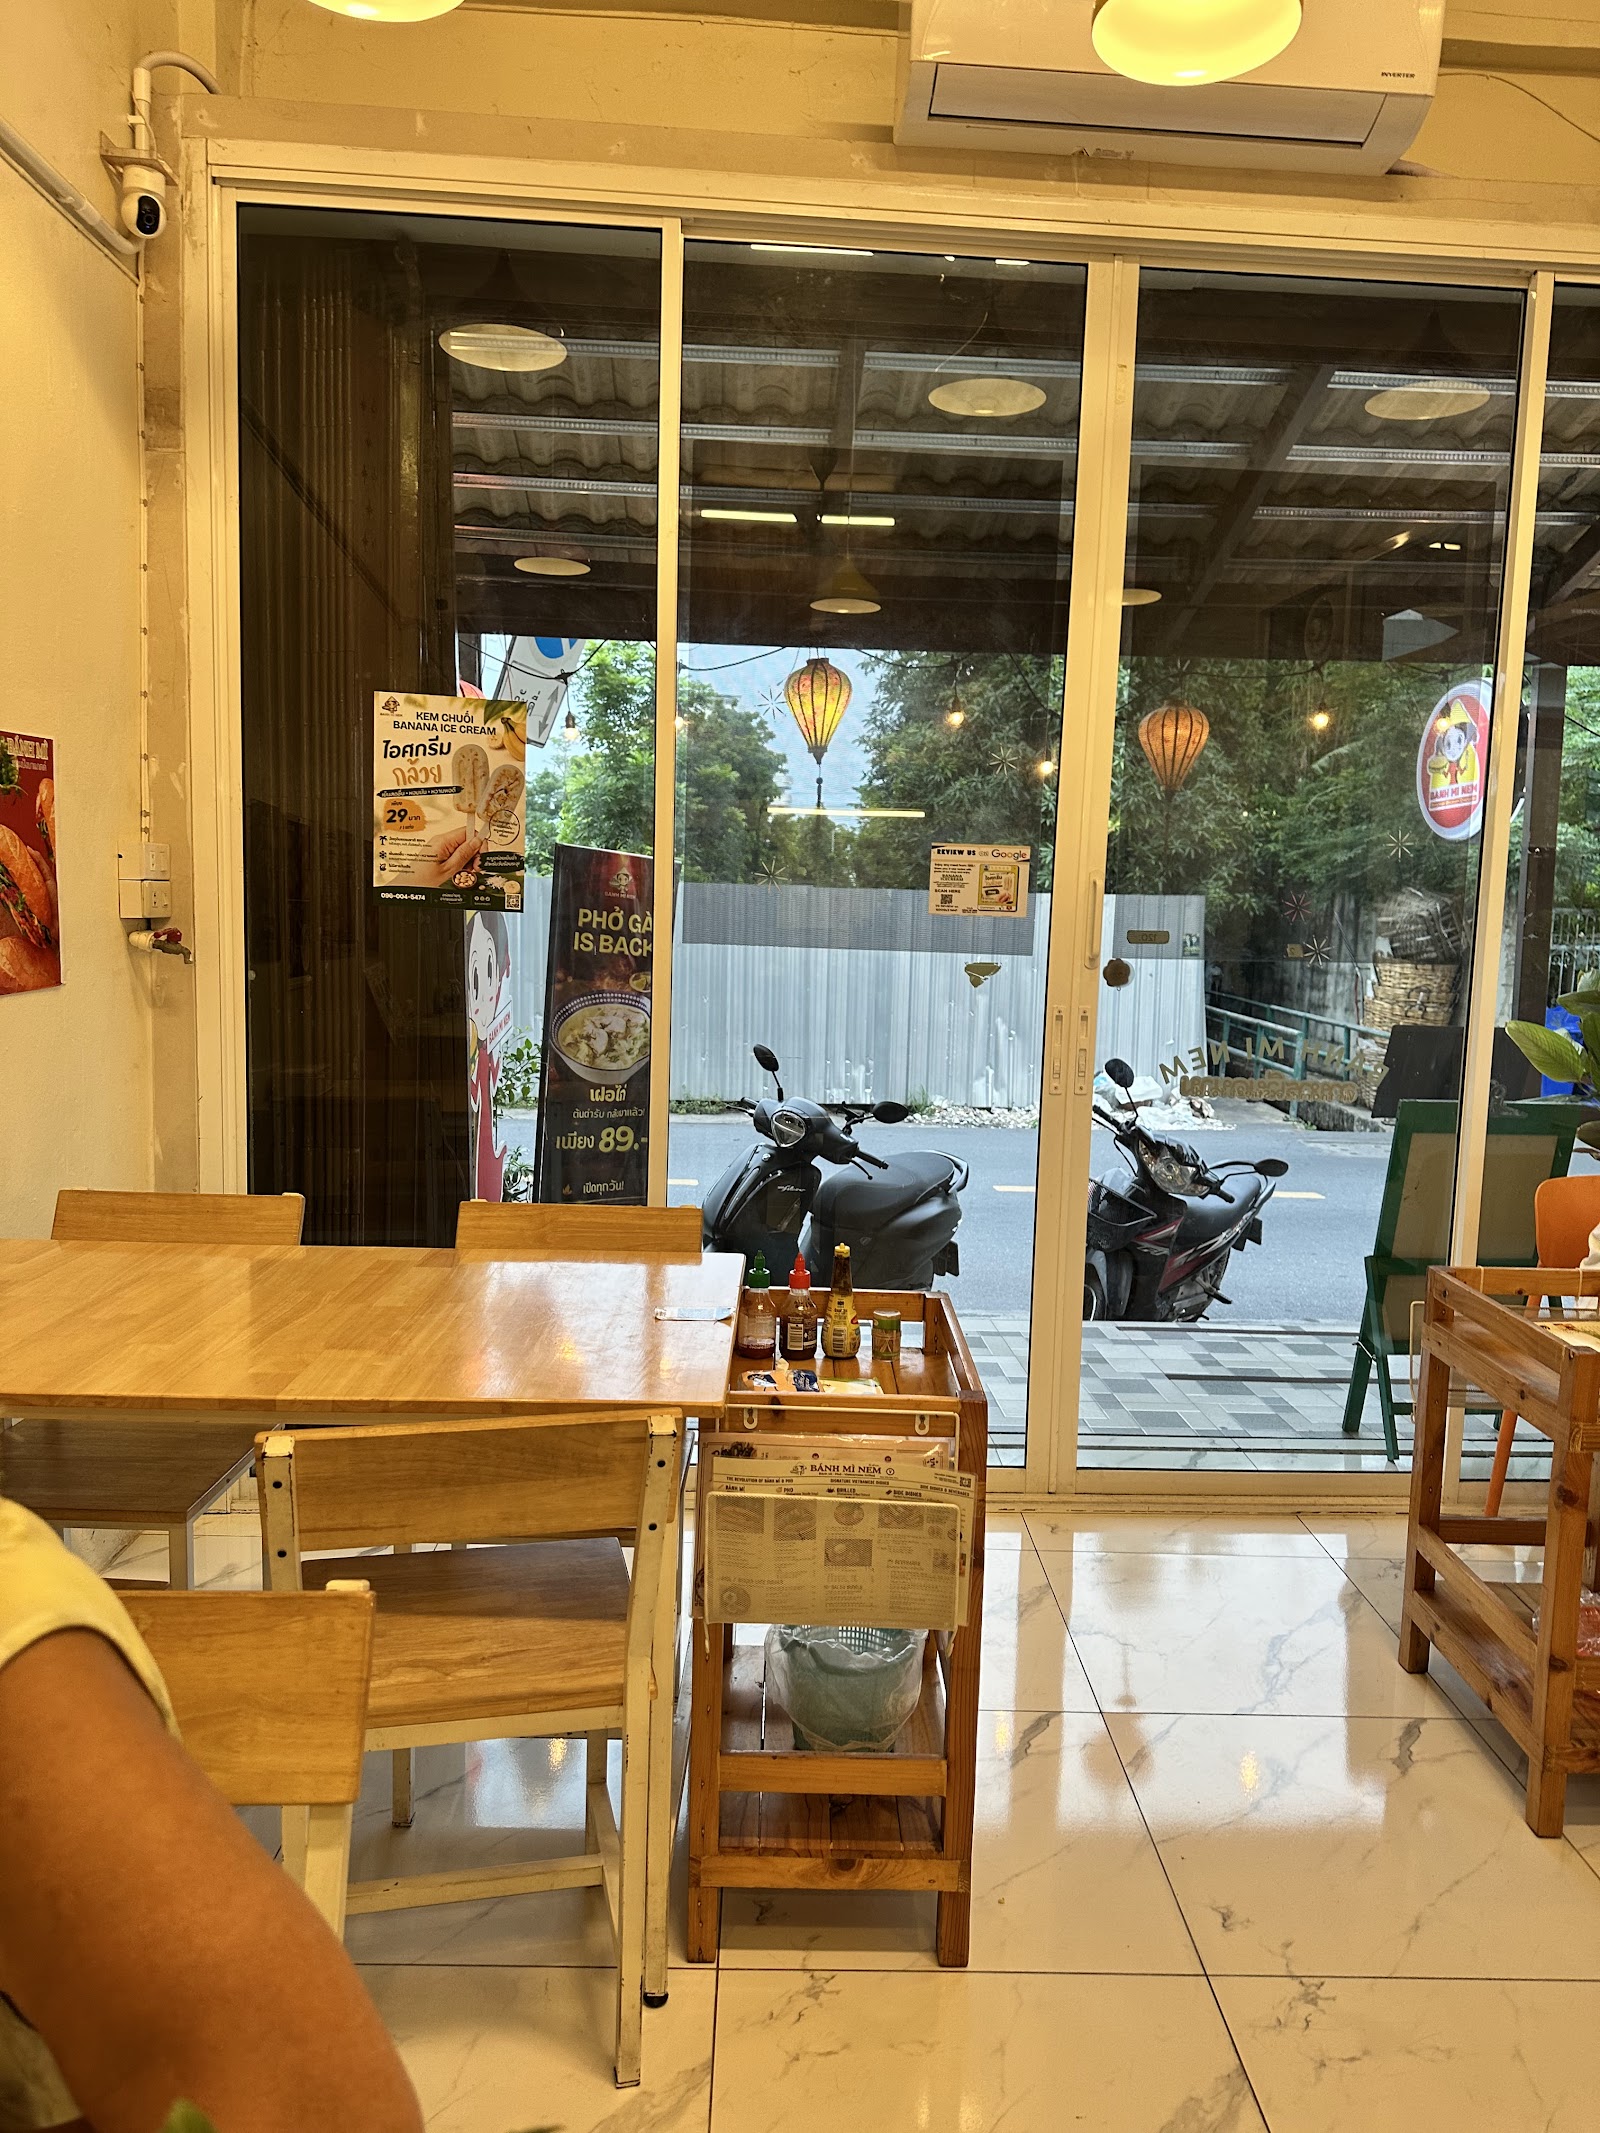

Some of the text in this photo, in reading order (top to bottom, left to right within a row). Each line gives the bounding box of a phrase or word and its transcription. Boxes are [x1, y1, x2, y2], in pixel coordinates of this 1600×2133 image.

[1381, 71, 1415, 79] INVERTER
[416, 711, 439, 721] KEM
[393, 720, 496, 736] BANANA ICE CREAM
[383, 735, 452, 759] ไอศกรีม
[392, 758, 442, 786] กล้วย
[386, 808, 408, 823] 29
[937, 848, 965, 856] REVIEW
[991, 848, 1027, 860] Google
[578, 905, 652, 934] PHỞ GÀ
[573, 931, 652, 957] IS BACK
[573, 1107, 605, 1119] ต้นตำรับ
[556, 1131, 595, 1150] เพียง
[583, 1180, 625, 1196] เปิดทุกวัน!
[810, 1463, 840, 1473] BÁNH
[842, 1463, 855, 1473] MÌ
